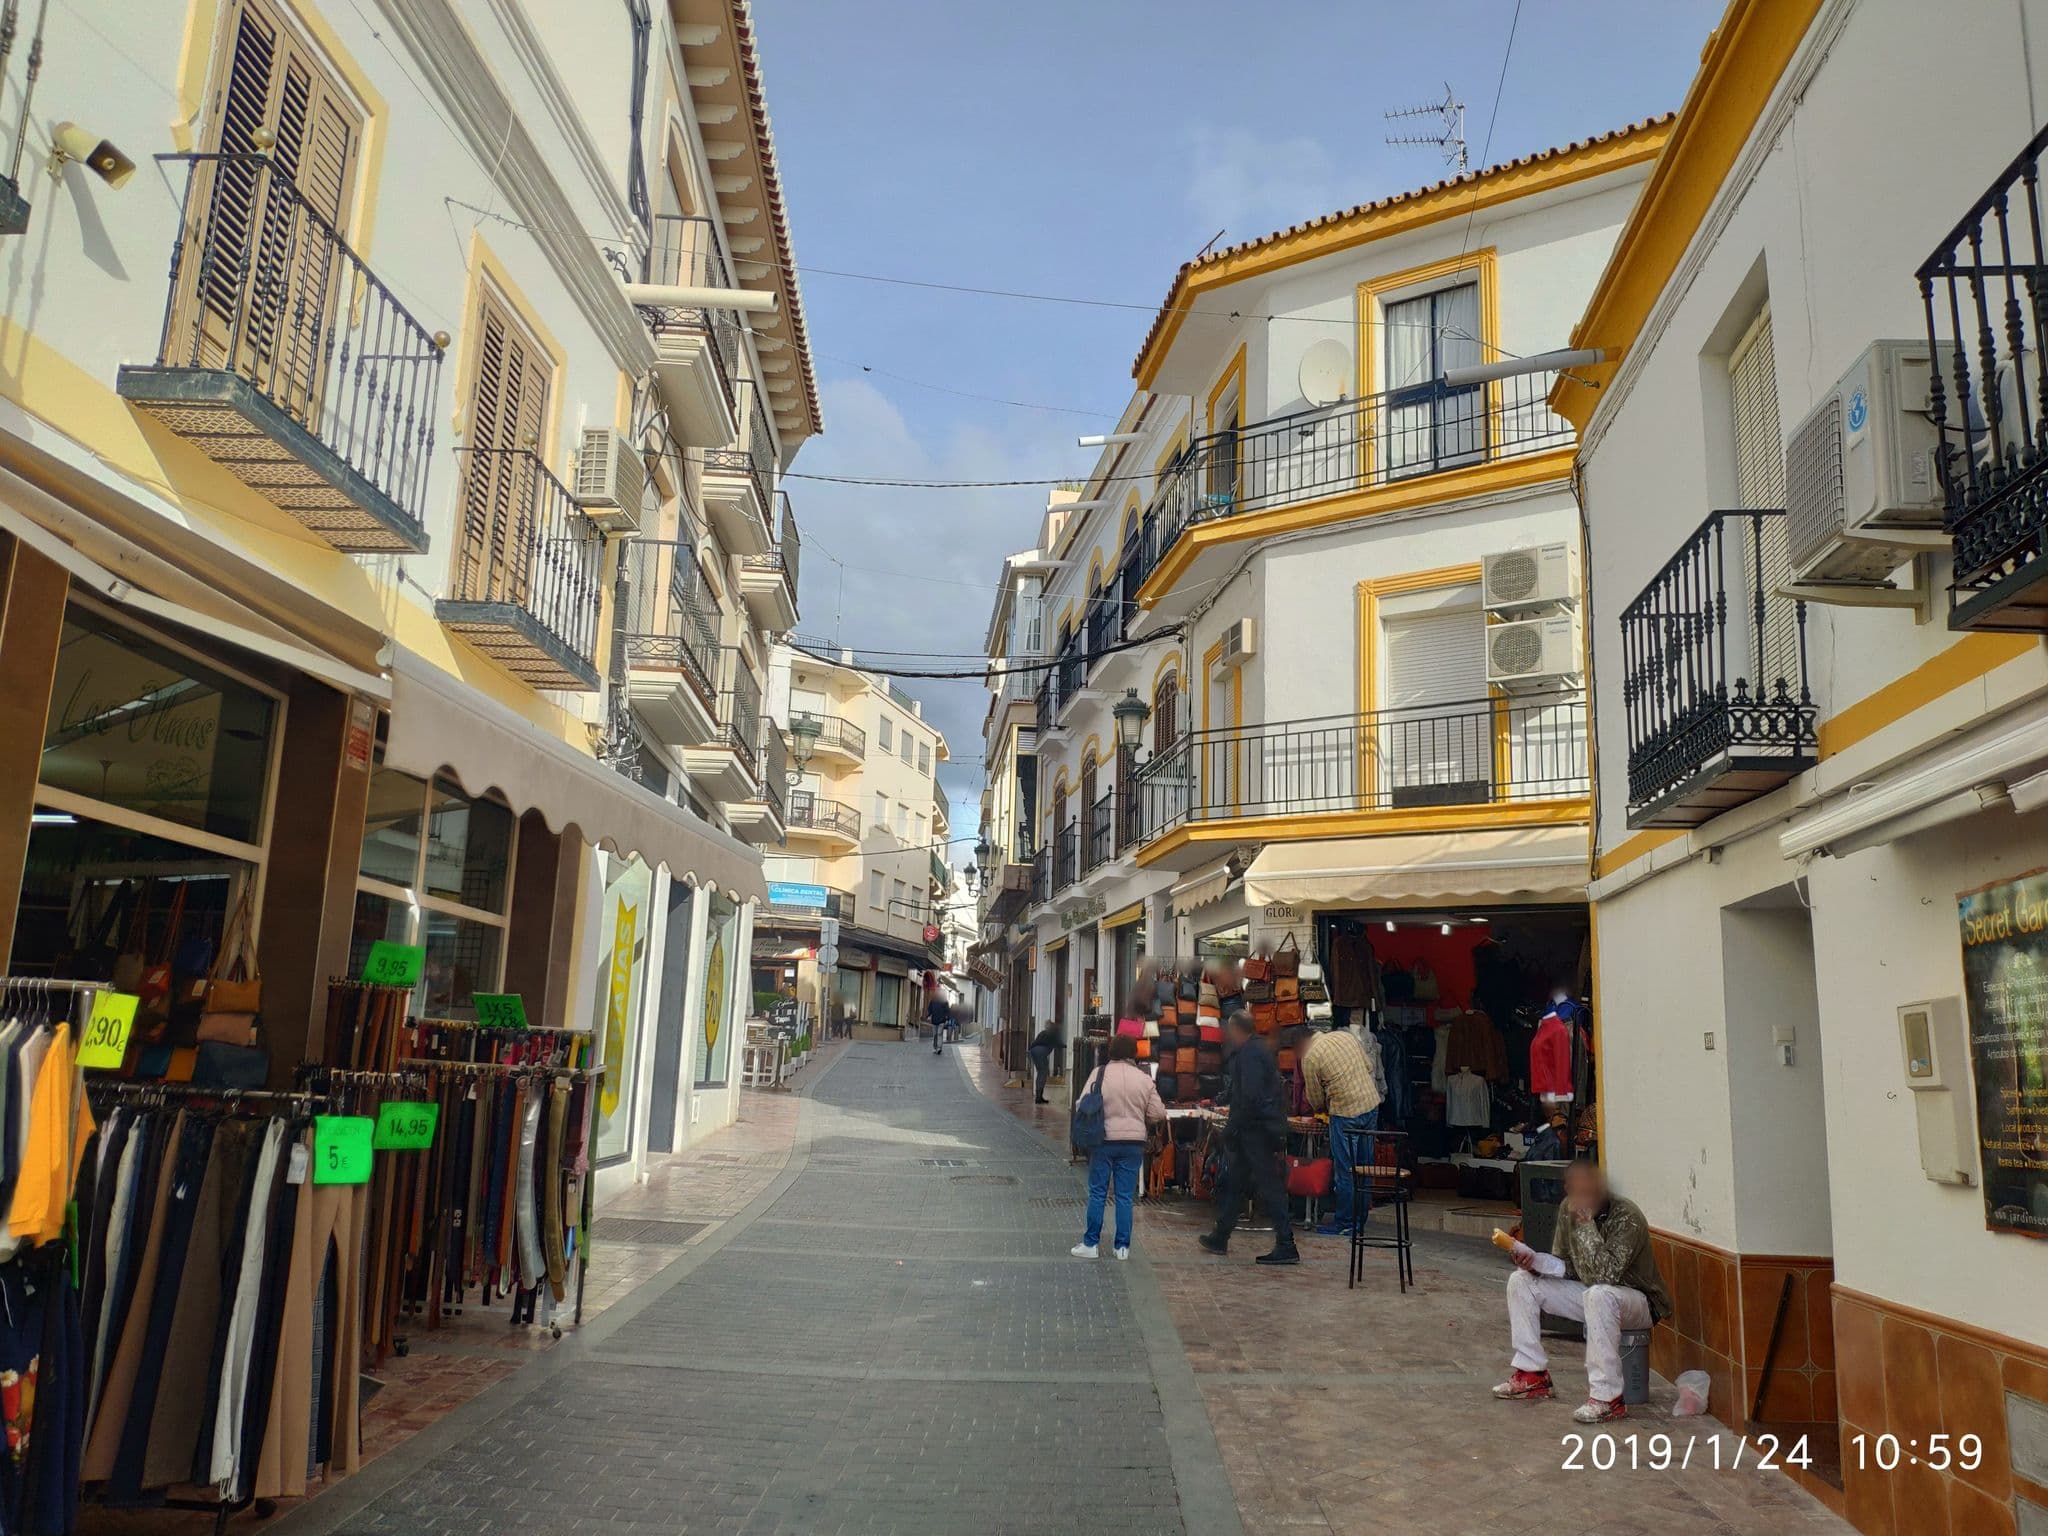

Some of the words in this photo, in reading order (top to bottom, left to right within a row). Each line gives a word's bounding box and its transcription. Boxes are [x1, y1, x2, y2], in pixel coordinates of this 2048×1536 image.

[1965, 902, 2013, 946] Secret
[2015, 888, 2048, 934] Gar
[376, 957, 408, 977] 9,95
[390, 1119, 428, 1139] 14,95
